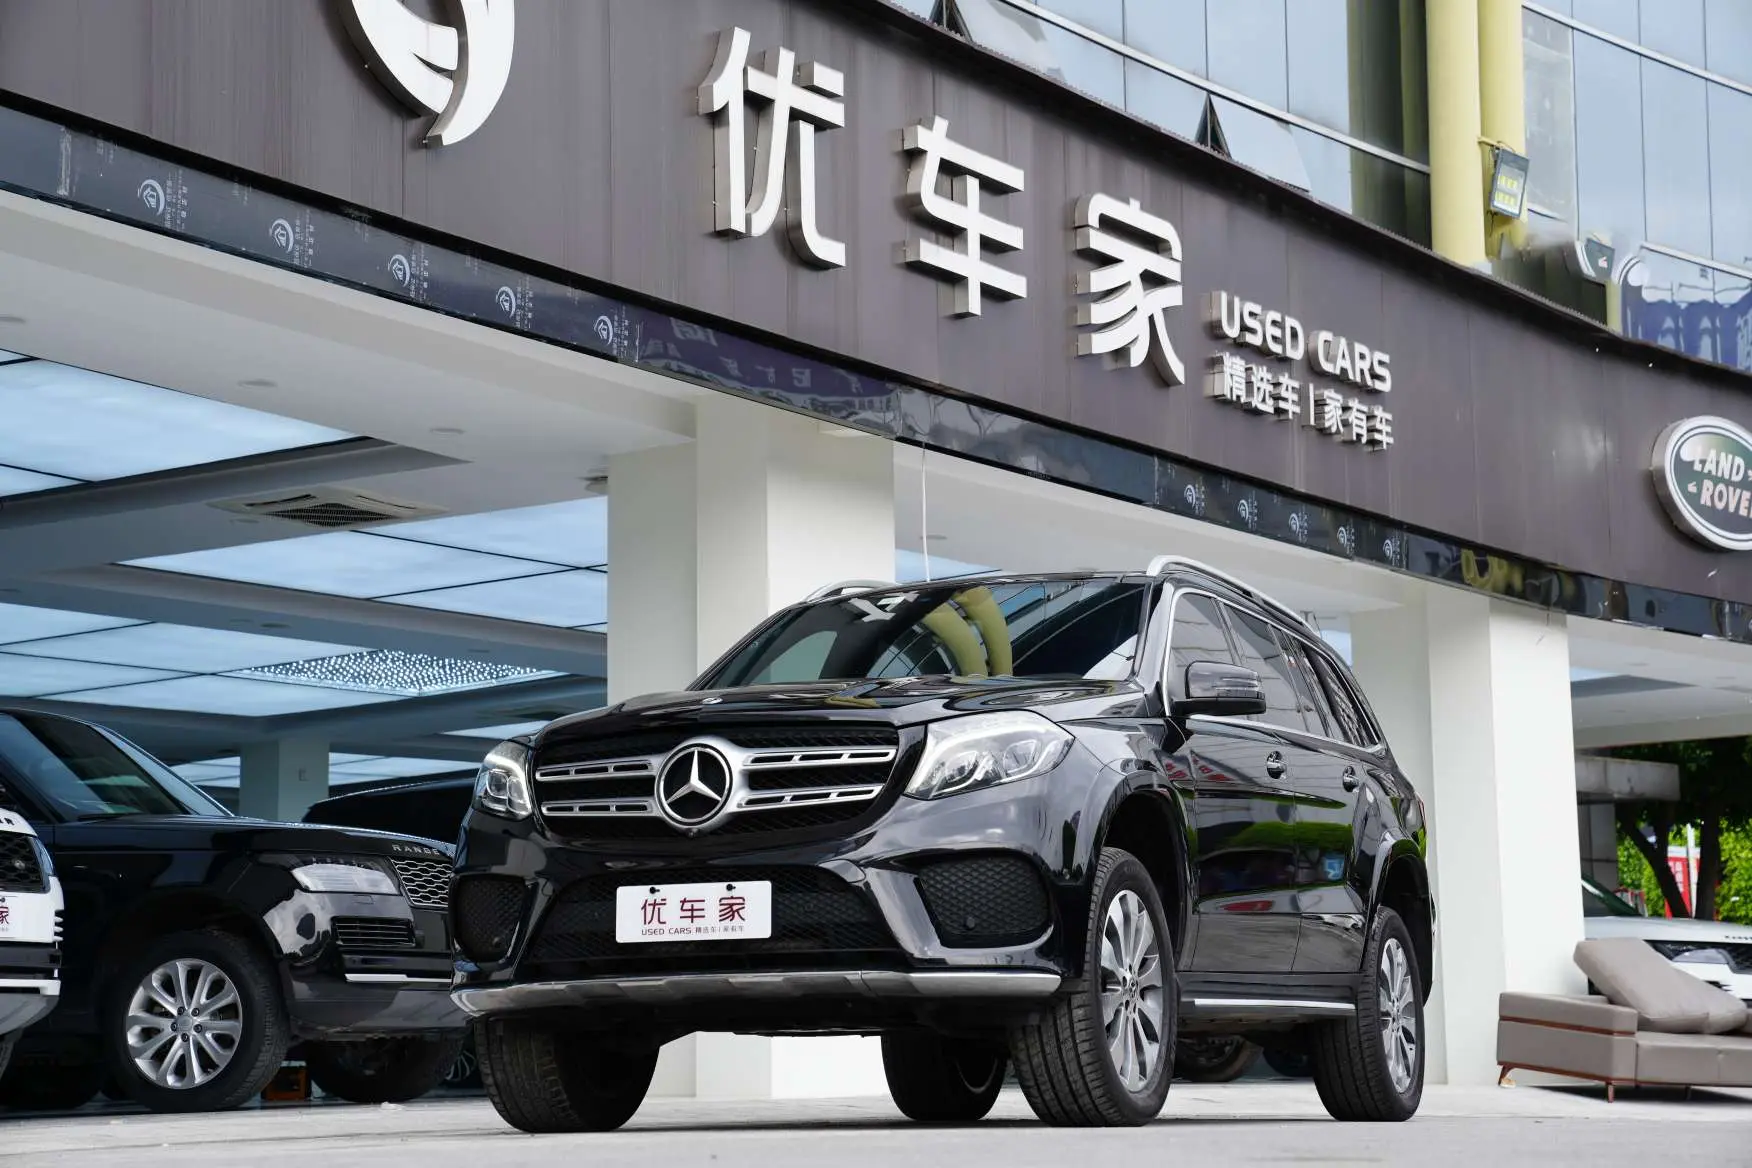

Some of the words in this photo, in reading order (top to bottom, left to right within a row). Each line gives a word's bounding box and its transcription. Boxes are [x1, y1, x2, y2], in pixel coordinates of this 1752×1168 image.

[698, 26, 1185, 386] 优车家
[1219, 290, 1305, 361] USED
[1316, 330, 1392, 393] CARS
[1693, 448, 1745, 482] LAND
[1700, 479, 1752, 518] ROVE
[392, 844, 440, 855] RANGE
[641, 896, 746, 925] 优车家
[641, 928, 665, 937] USED
[668, 927, 692, 935] CARS
